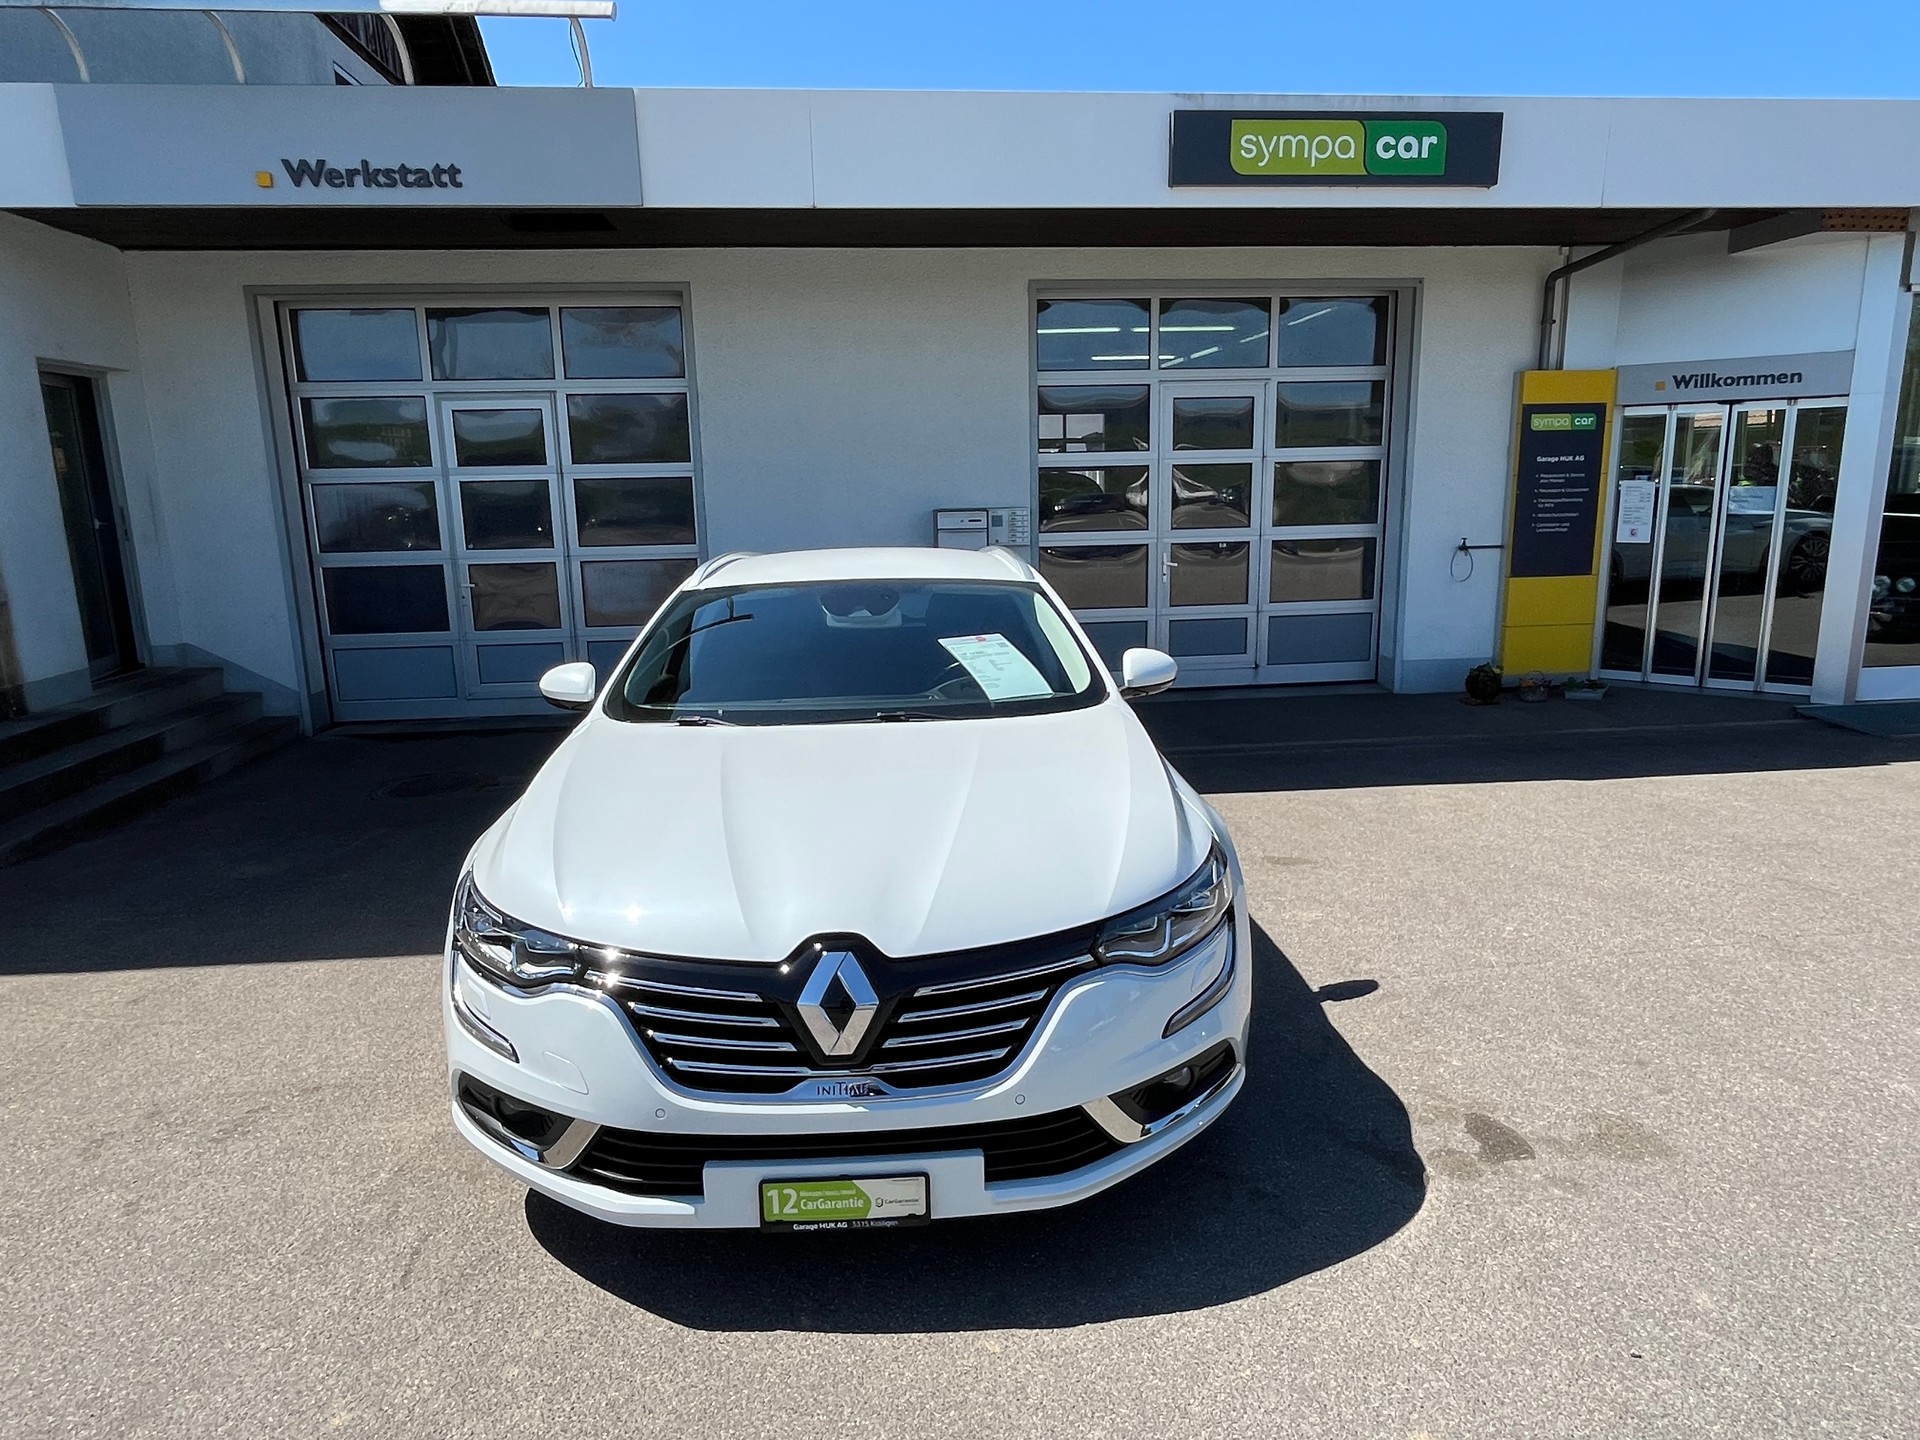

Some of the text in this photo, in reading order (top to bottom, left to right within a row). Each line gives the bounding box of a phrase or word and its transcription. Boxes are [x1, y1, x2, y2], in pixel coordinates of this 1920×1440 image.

[1240, 133, 1438, 167] sympa car
[280, 158, 463, 189] Werkstatt
[1672, 369, 1803, 390] Willkommen
[1533, 416, 1595, 429] sympa car
[1536, 455, 1559, 463] Garage
[767, 1188, 799, 1215] 12
[800, 1196, 864, 1210] CarGarantie
[793, 1222, 819, 1231] Garage
